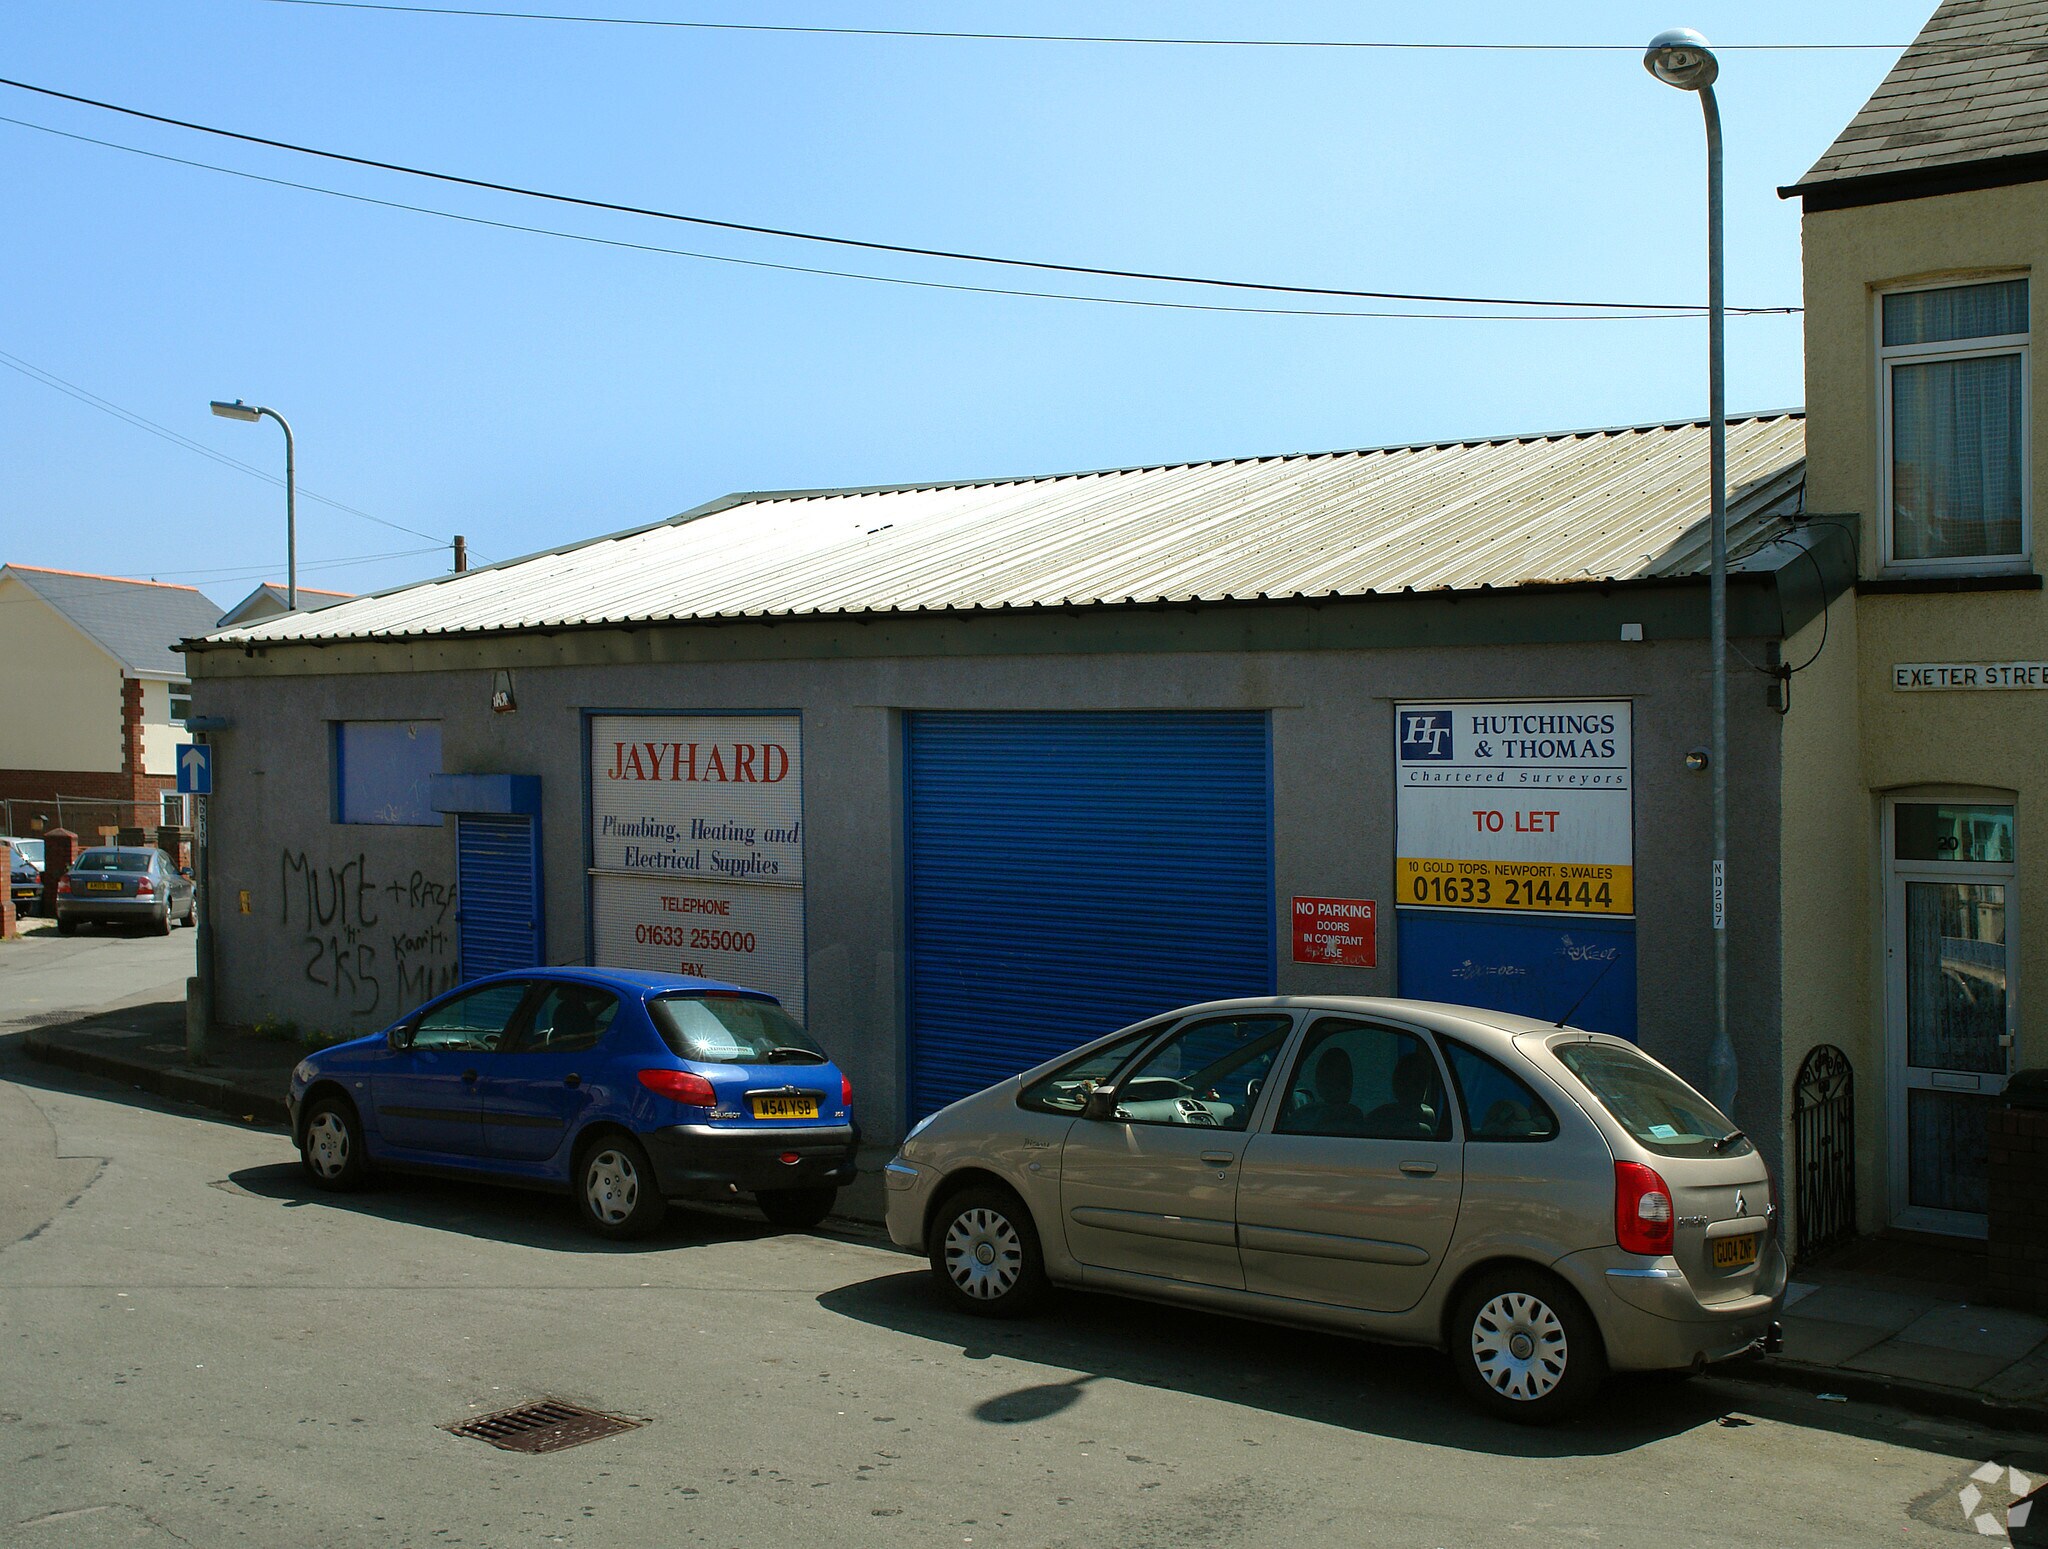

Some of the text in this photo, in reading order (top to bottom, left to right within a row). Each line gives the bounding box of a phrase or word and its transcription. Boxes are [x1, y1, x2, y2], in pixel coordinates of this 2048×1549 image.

[1897, 669, 1977, 686] EXETER
[1472, 715, 1615, 734] HUTCHINGS
[1404, 716, 1449, 755] HT
[1474, 739, 1616, 758] & THOMAS
[608, 742, 789, 783] JAYHARD
[1410, 771, 1623, 786] Chartered Surveyors
[603, 815, 800, 846] Plumbing, Heating and
[1473, 811, 1560, 832] TO LET
[1938, 836, 1959, 851] 20
[625, 846, 779, 876] Electrical Supplies
[1409, 862, 1418, 872] 10
[1424, 862, 1454, 874] GOLD
[1561, 868, 1613, 879] S.WALES
[1413, 876, 1613, 908] 01633 214444
[1714, 863, 1723, 926] ND297
[661, 896, 730, 915] TELEPHONE
[1296, 902, 1371, 918] NO PARKING
[1317, 921, 1349, 931] DOORS
[635, 924, 755, 953] 01633 255000
[1304, 933, 1363, 945] IN CONSTANT
[1324, 948, 1343, 958] USE
[761, 1099, 811, 1115] W541 YSB
[1717, 1242, 1738, 1263] GU04
